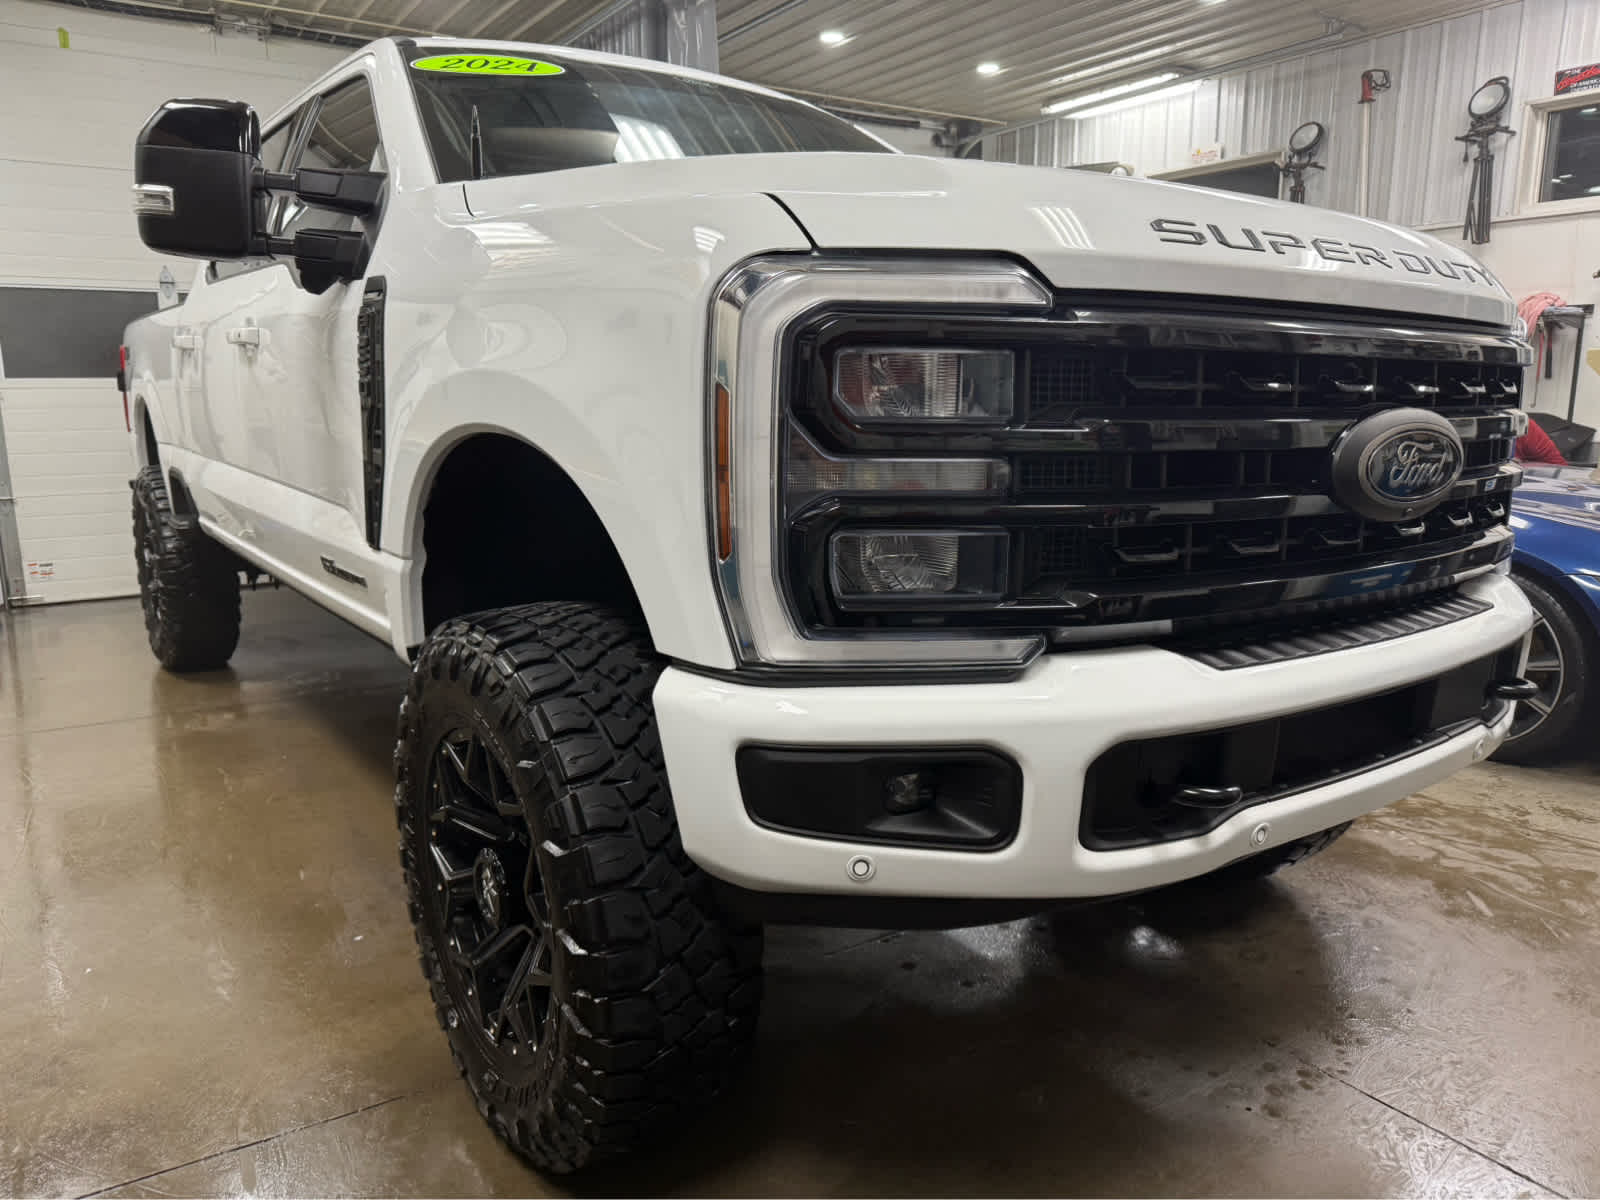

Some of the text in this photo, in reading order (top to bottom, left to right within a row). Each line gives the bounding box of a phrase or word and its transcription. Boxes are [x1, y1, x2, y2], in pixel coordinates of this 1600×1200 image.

[440, 57, 539, 73] 2024
[1149, 218, 1496, 287] SUPER DUTY
[1389, 440, 1447, 488] Ford
